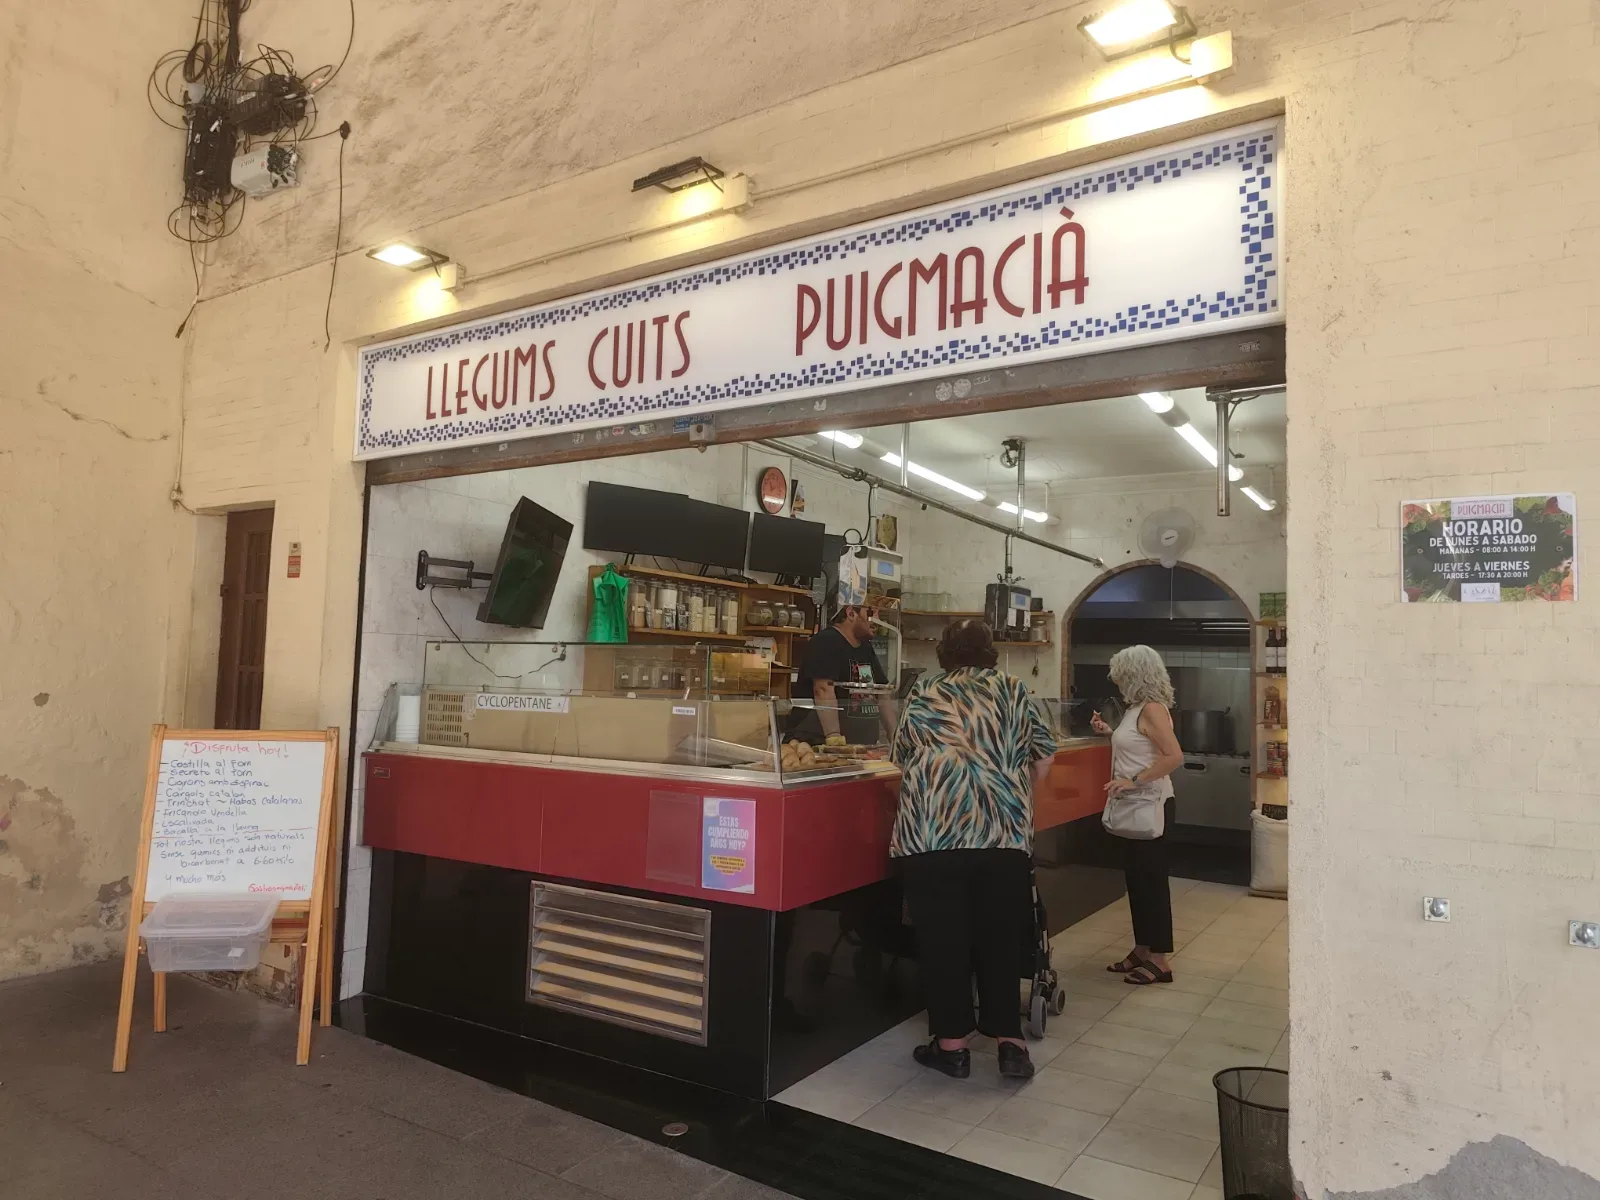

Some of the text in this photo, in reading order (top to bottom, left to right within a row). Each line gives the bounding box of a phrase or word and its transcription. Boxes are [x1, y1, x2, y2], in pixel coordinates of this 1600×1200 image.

[425, 205, 1090, 420] LLEGUMS CUITS PUIGMACIÀ
[1442, 518, 1523, 537] HORARIO
[1429, 533, 1537, 547] DE LUNES A SABADO
[1482, 546, 1502, 554] 08:00
[1432, 560, 1530, 573] JUEVES A VIERNES
[1442, 572, 1469, 580] TARDES
[1478, 571, 1495, 579] 17:30
[477, 694, 552, 711] CYCLOPENTANE
[257, 742, 290, 759] hoy!
[170, 758, 211, 769] Costilla
[215, 758, 226, 767] al
[215, 768, 225, 777] al
[167, 798, 210, 807] Trinchat
[719, 816, 739, 828] ESTAS
[707, 826, 749, 841] CUMPLIENDO
[728, 839, 747, 851] HOY?
[175, 873, 202, 884] mucho
